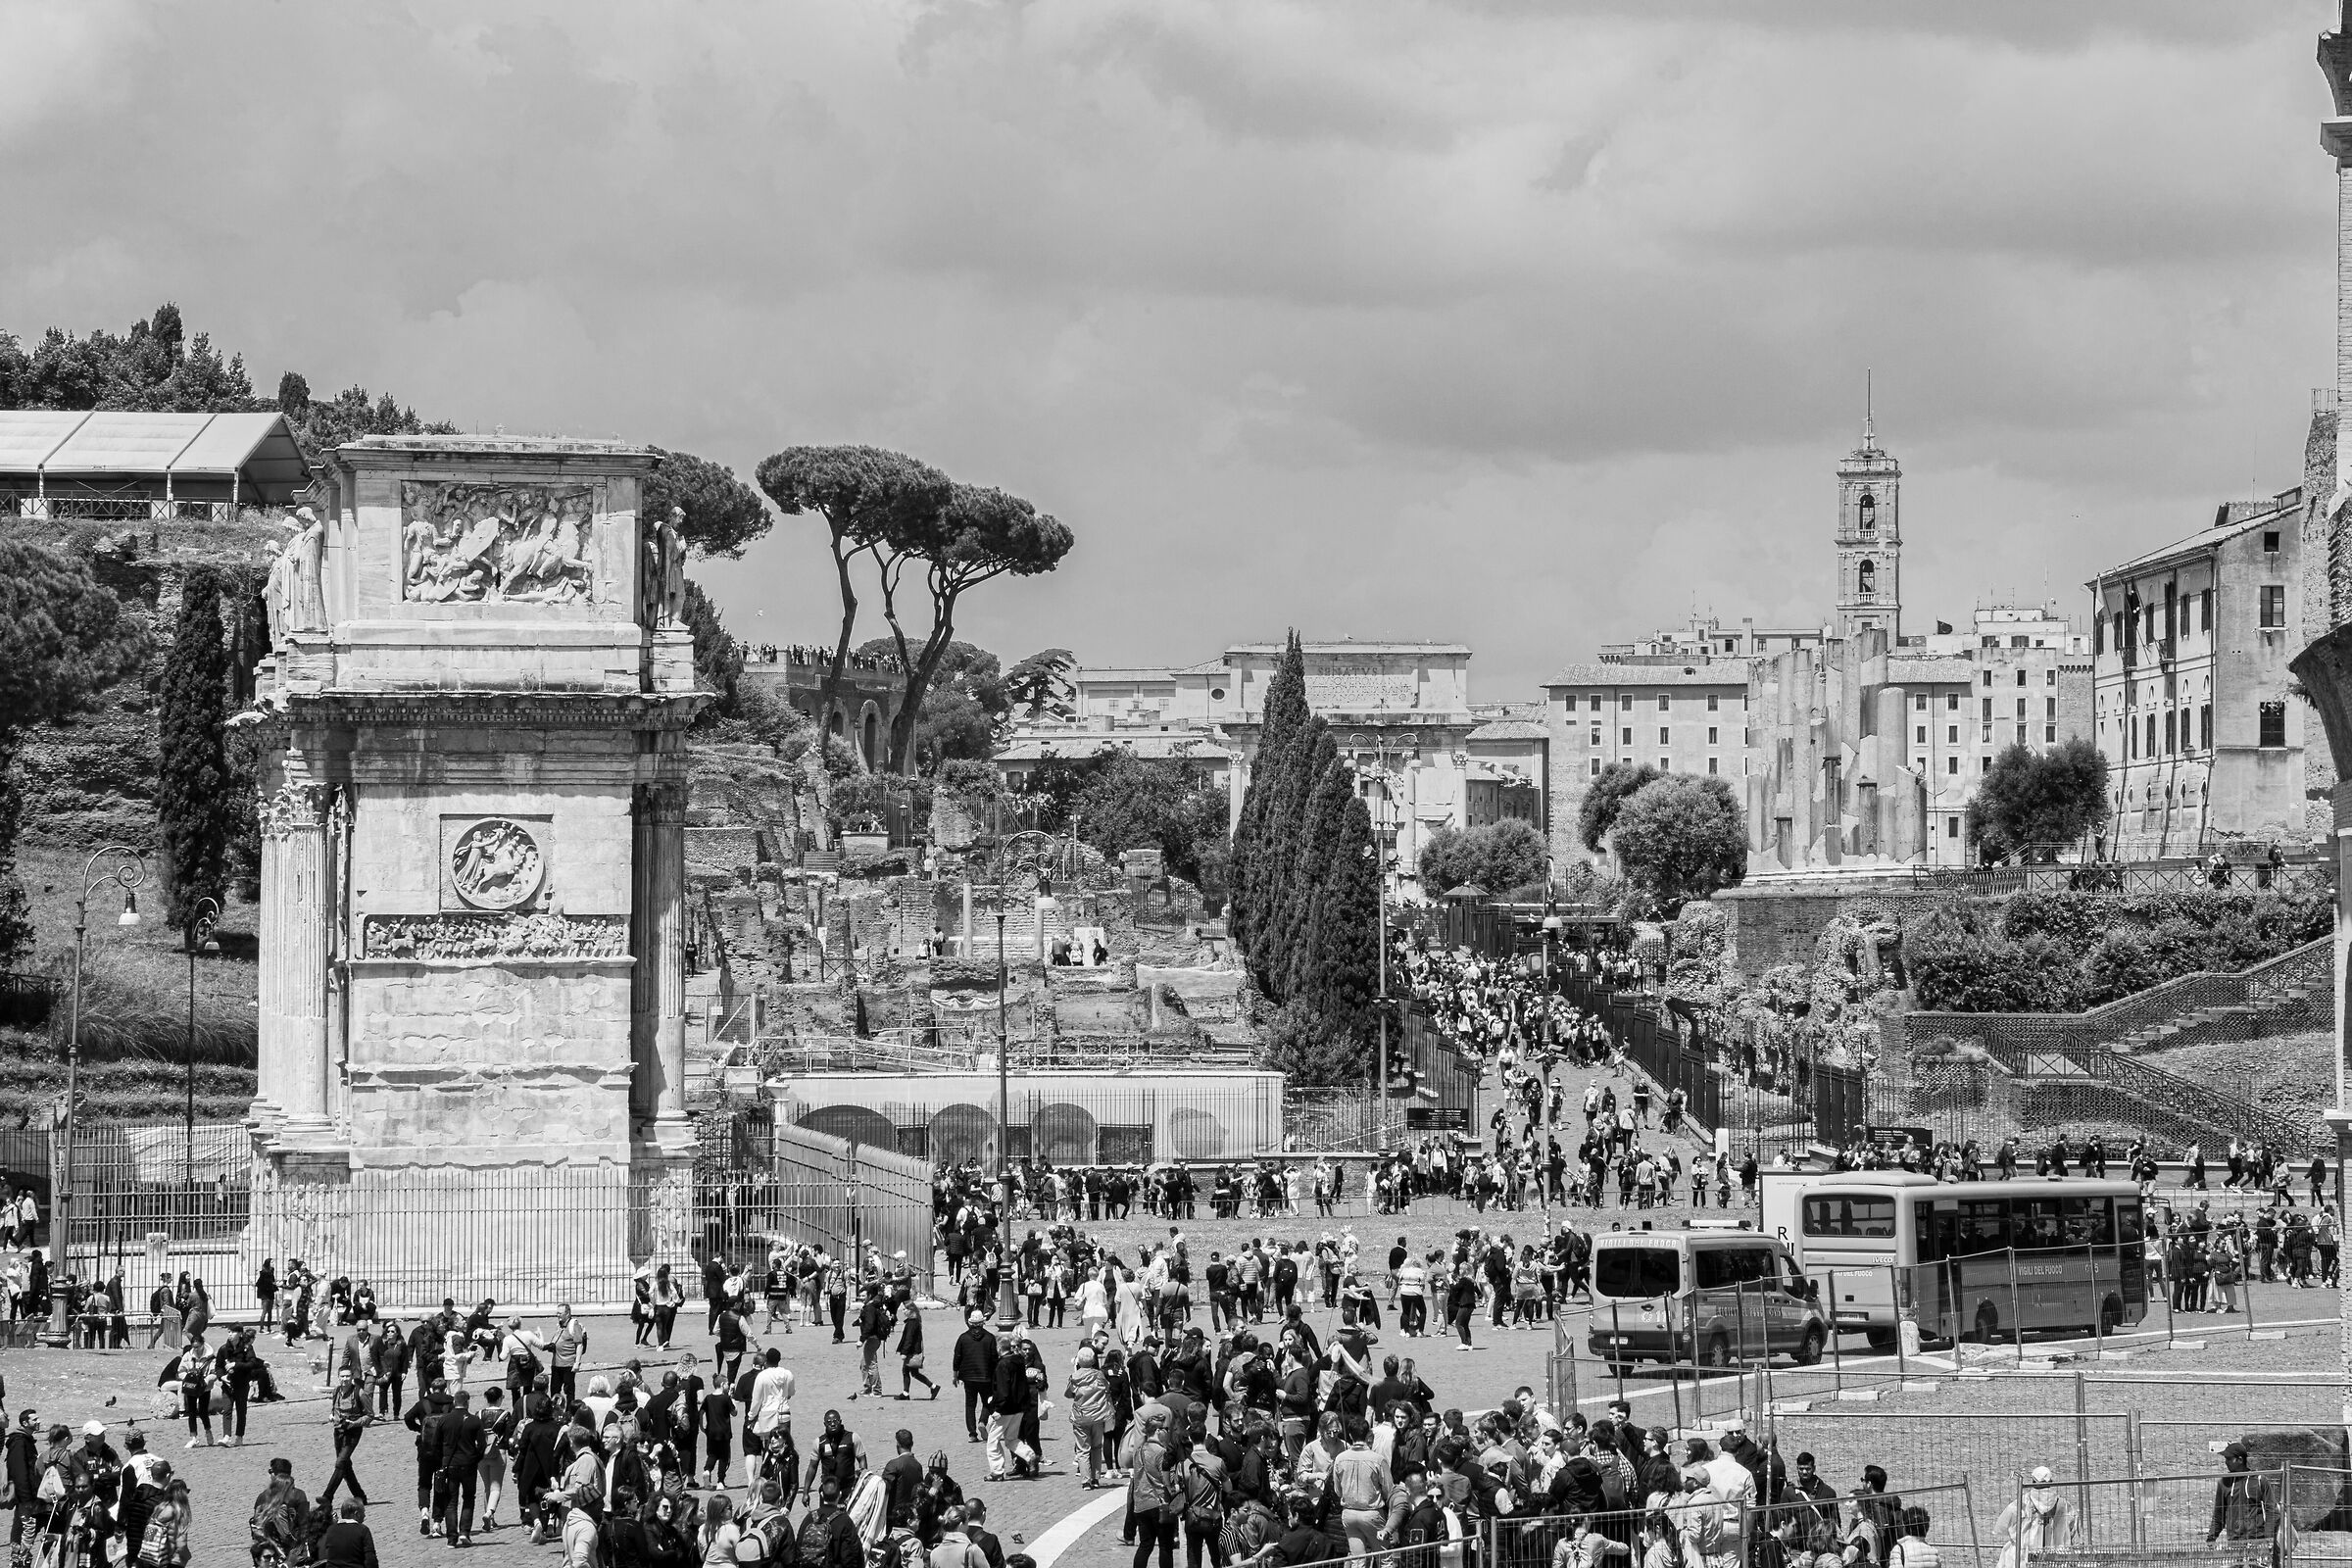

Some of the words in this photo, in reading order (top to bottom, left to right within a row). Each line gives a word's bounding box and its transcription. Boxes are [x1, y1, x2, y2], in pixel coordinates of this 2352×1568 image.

[1317, 666, 1379, 676] SENATVS
[1778, 1226, 1788, 1240] R
[1600, 1239, 1626, 1248] VIGILI
[1648, 1239, 1677, 1248] FUOCO
[2018, 1265, 2034, 1276] VIGILI
[2034, 1265, 2044, 1275] DEL
[2044, 1264, 2063, 1275] FUOCO
